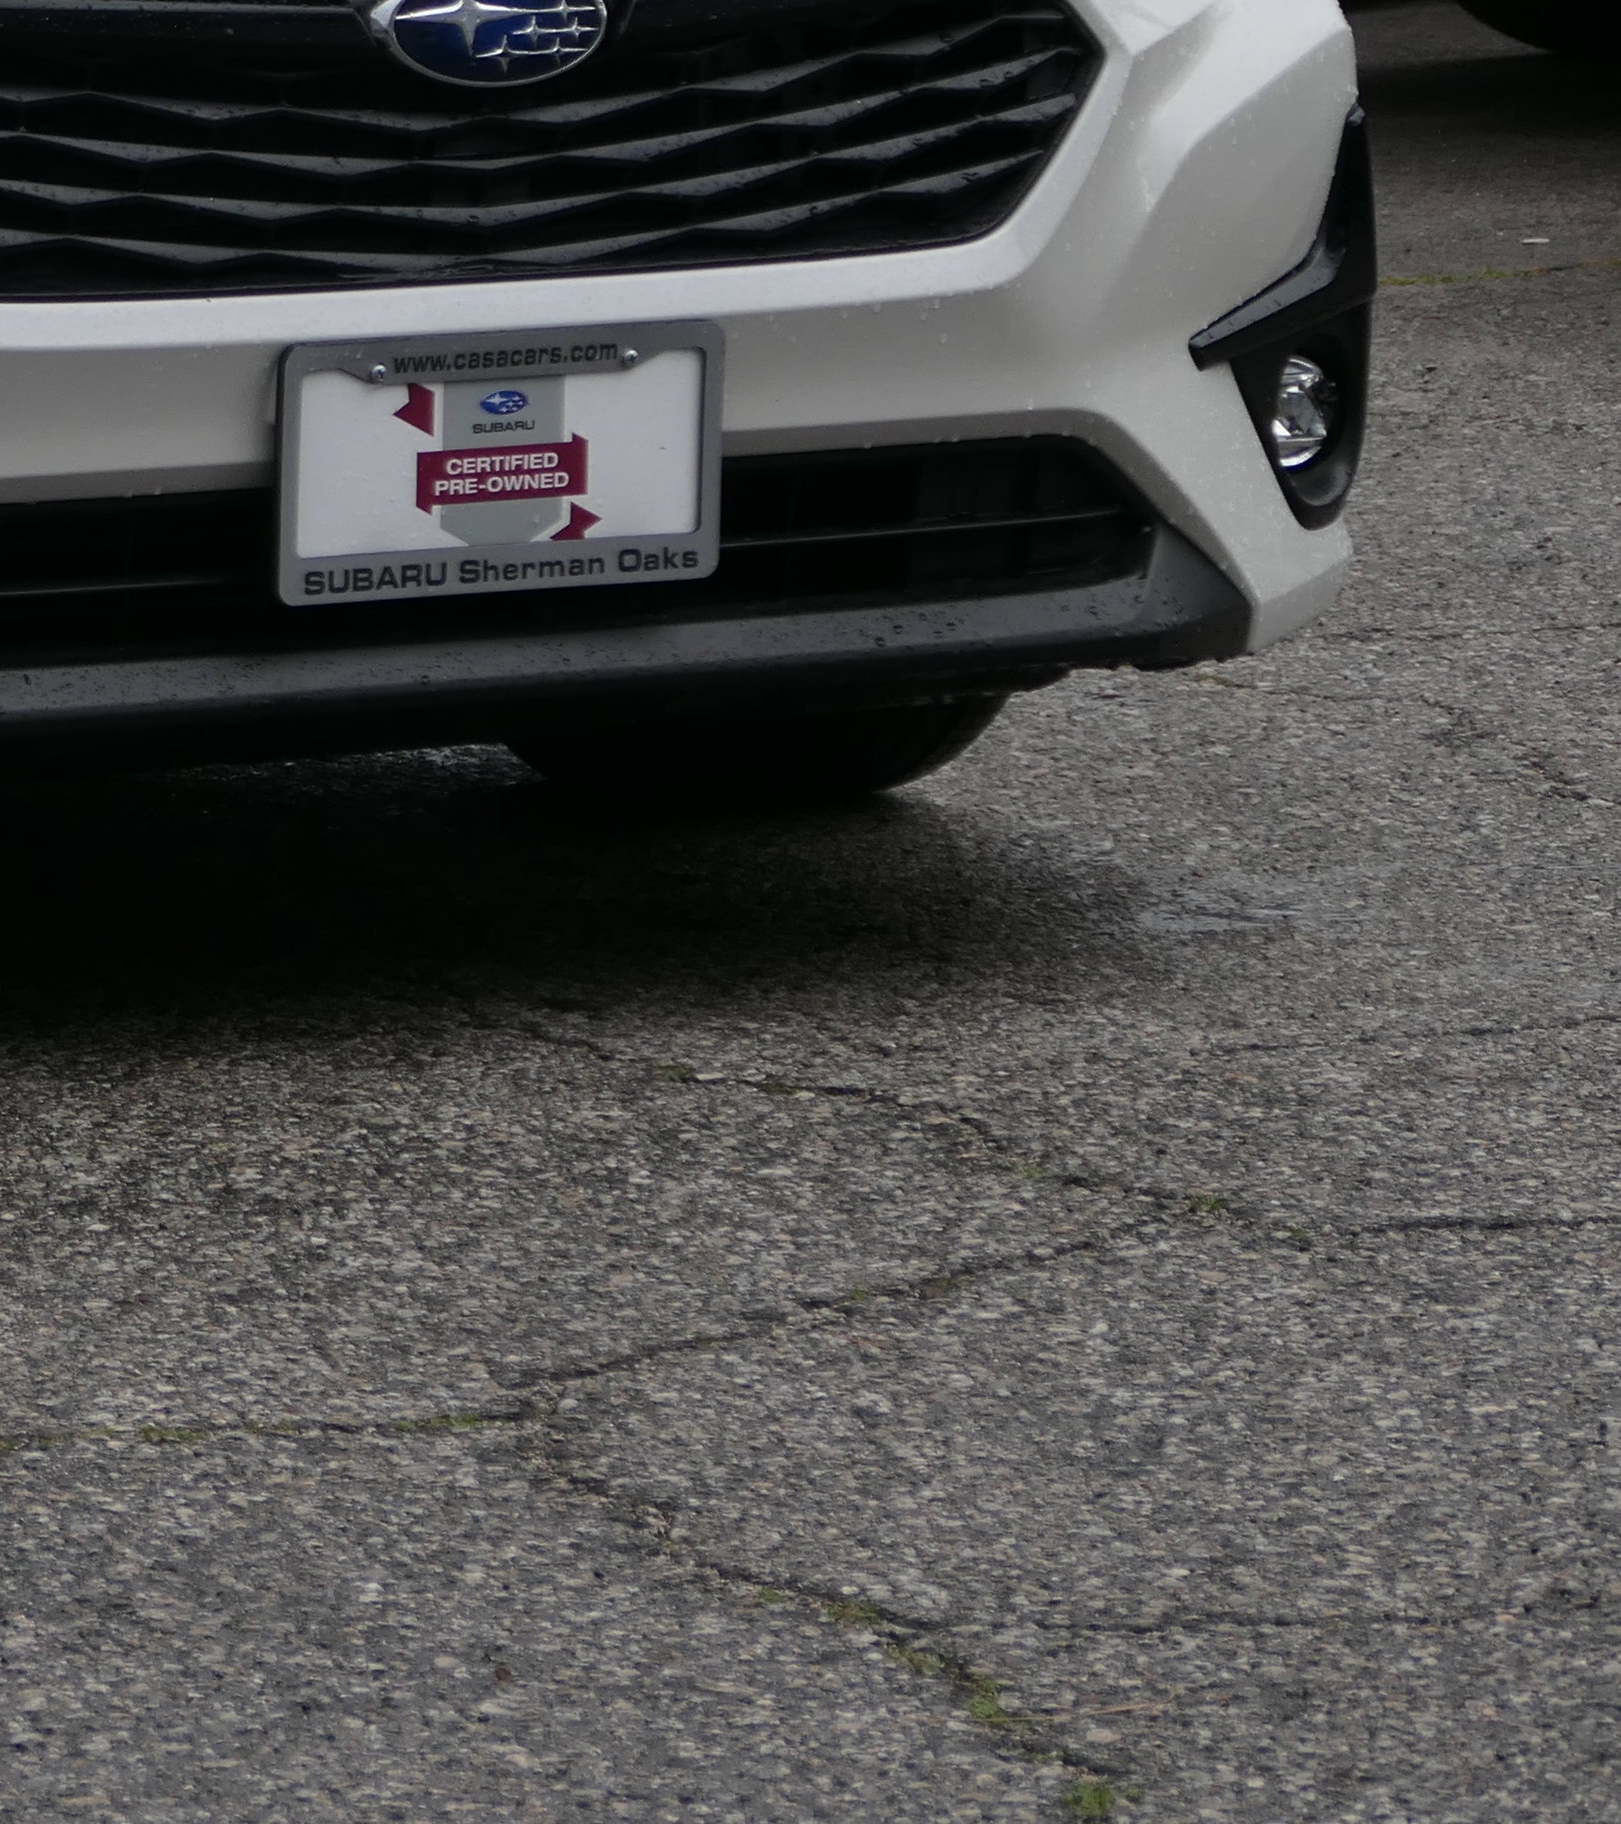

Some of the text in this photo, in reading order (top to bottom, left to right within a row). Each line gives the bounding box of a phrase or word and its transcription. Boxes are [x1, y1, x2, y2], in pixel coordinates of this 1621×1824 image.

[393, 340, 619, 375] www.casacars.com
[472, 419, 536, 435] SUBARU
[445, 452, 560, 476] CERTIFIED
[434, 471, 570, 497] PRE-OWNED
[303, 545, 699, 597] SUBARU Sherman Oaks
